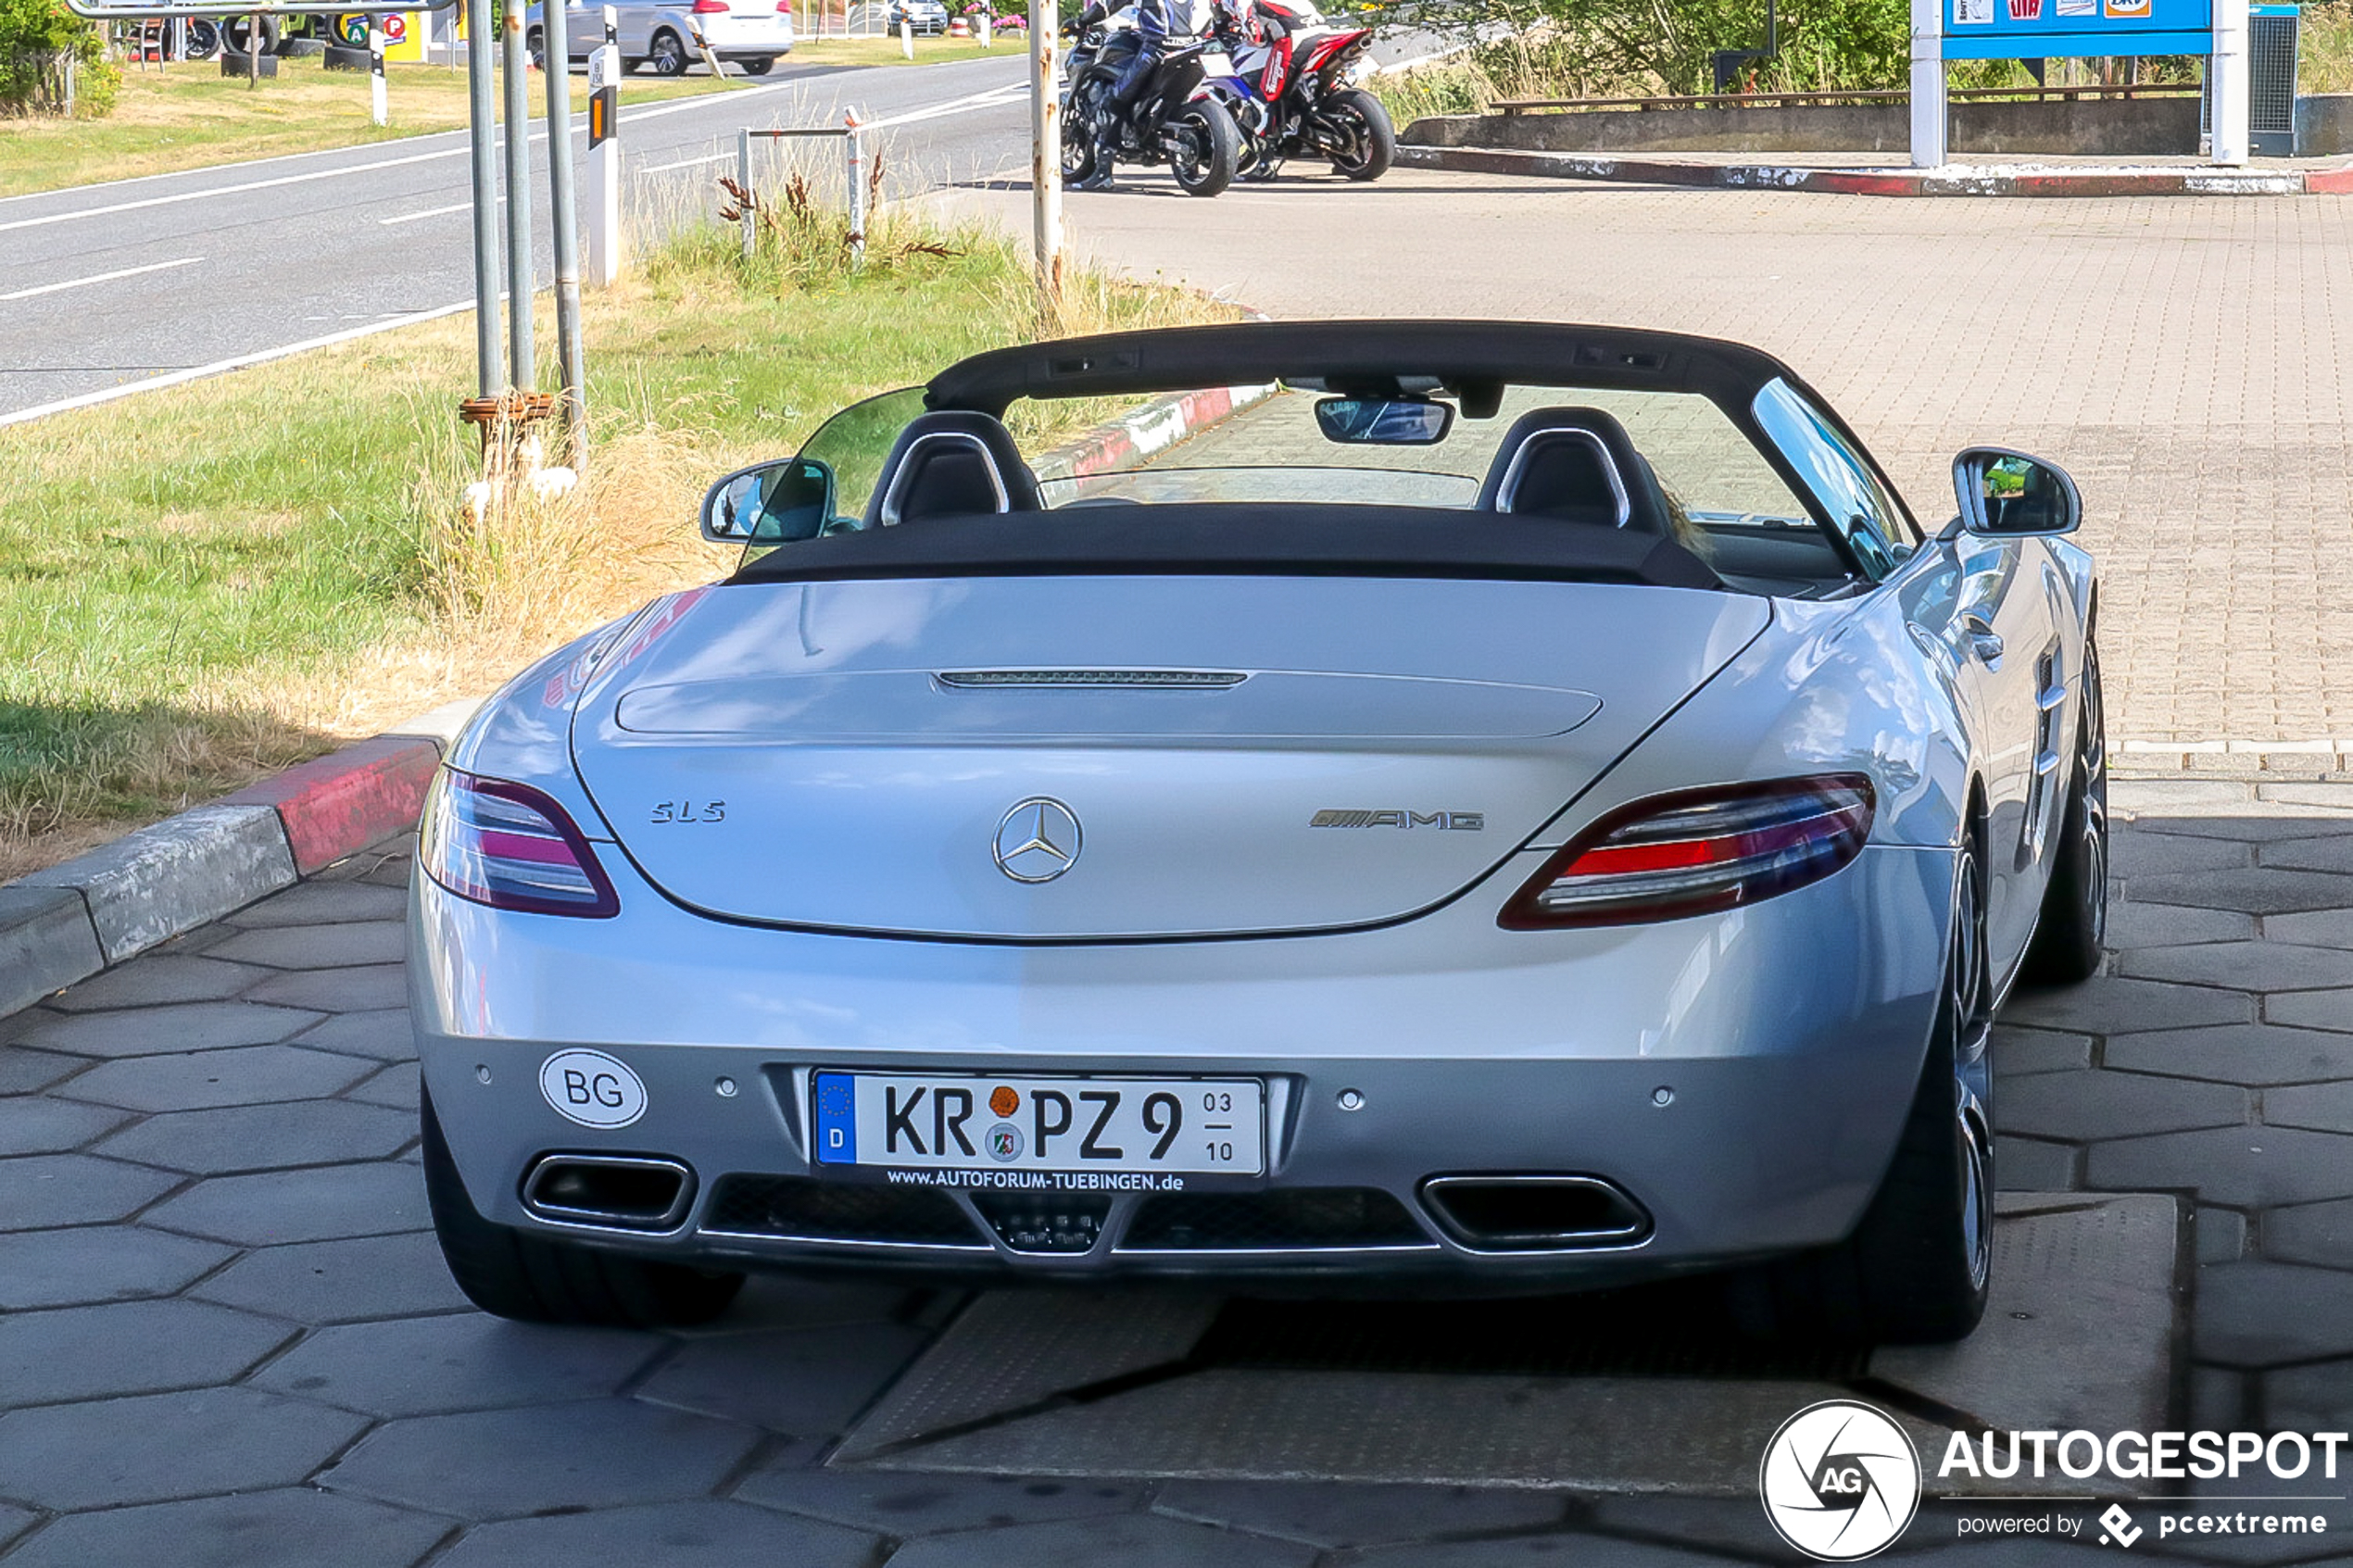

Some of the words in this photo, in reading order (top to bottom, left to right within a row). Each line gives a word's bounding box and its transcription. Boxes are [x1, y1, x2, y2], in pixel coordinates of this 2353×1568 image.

[650, 800, 726, 824] SLS
[1364, 809, 1484, 831] AMG
[564, 1069, 623, 1108] BG
[1203, 1092, 1232, 1112] 03
[886, 1085, 976, 1157] KR
[1030, 1089, 1124, 1160] PZ
[1141, 1091, 1183, 1160] 9
[829, 1128, 844, 1148] D
[1205, 1142, 1233, 1161] 10
[887, 1170, 1184, 1191] www.AUTOFORUM-TUEBINGEN.de
